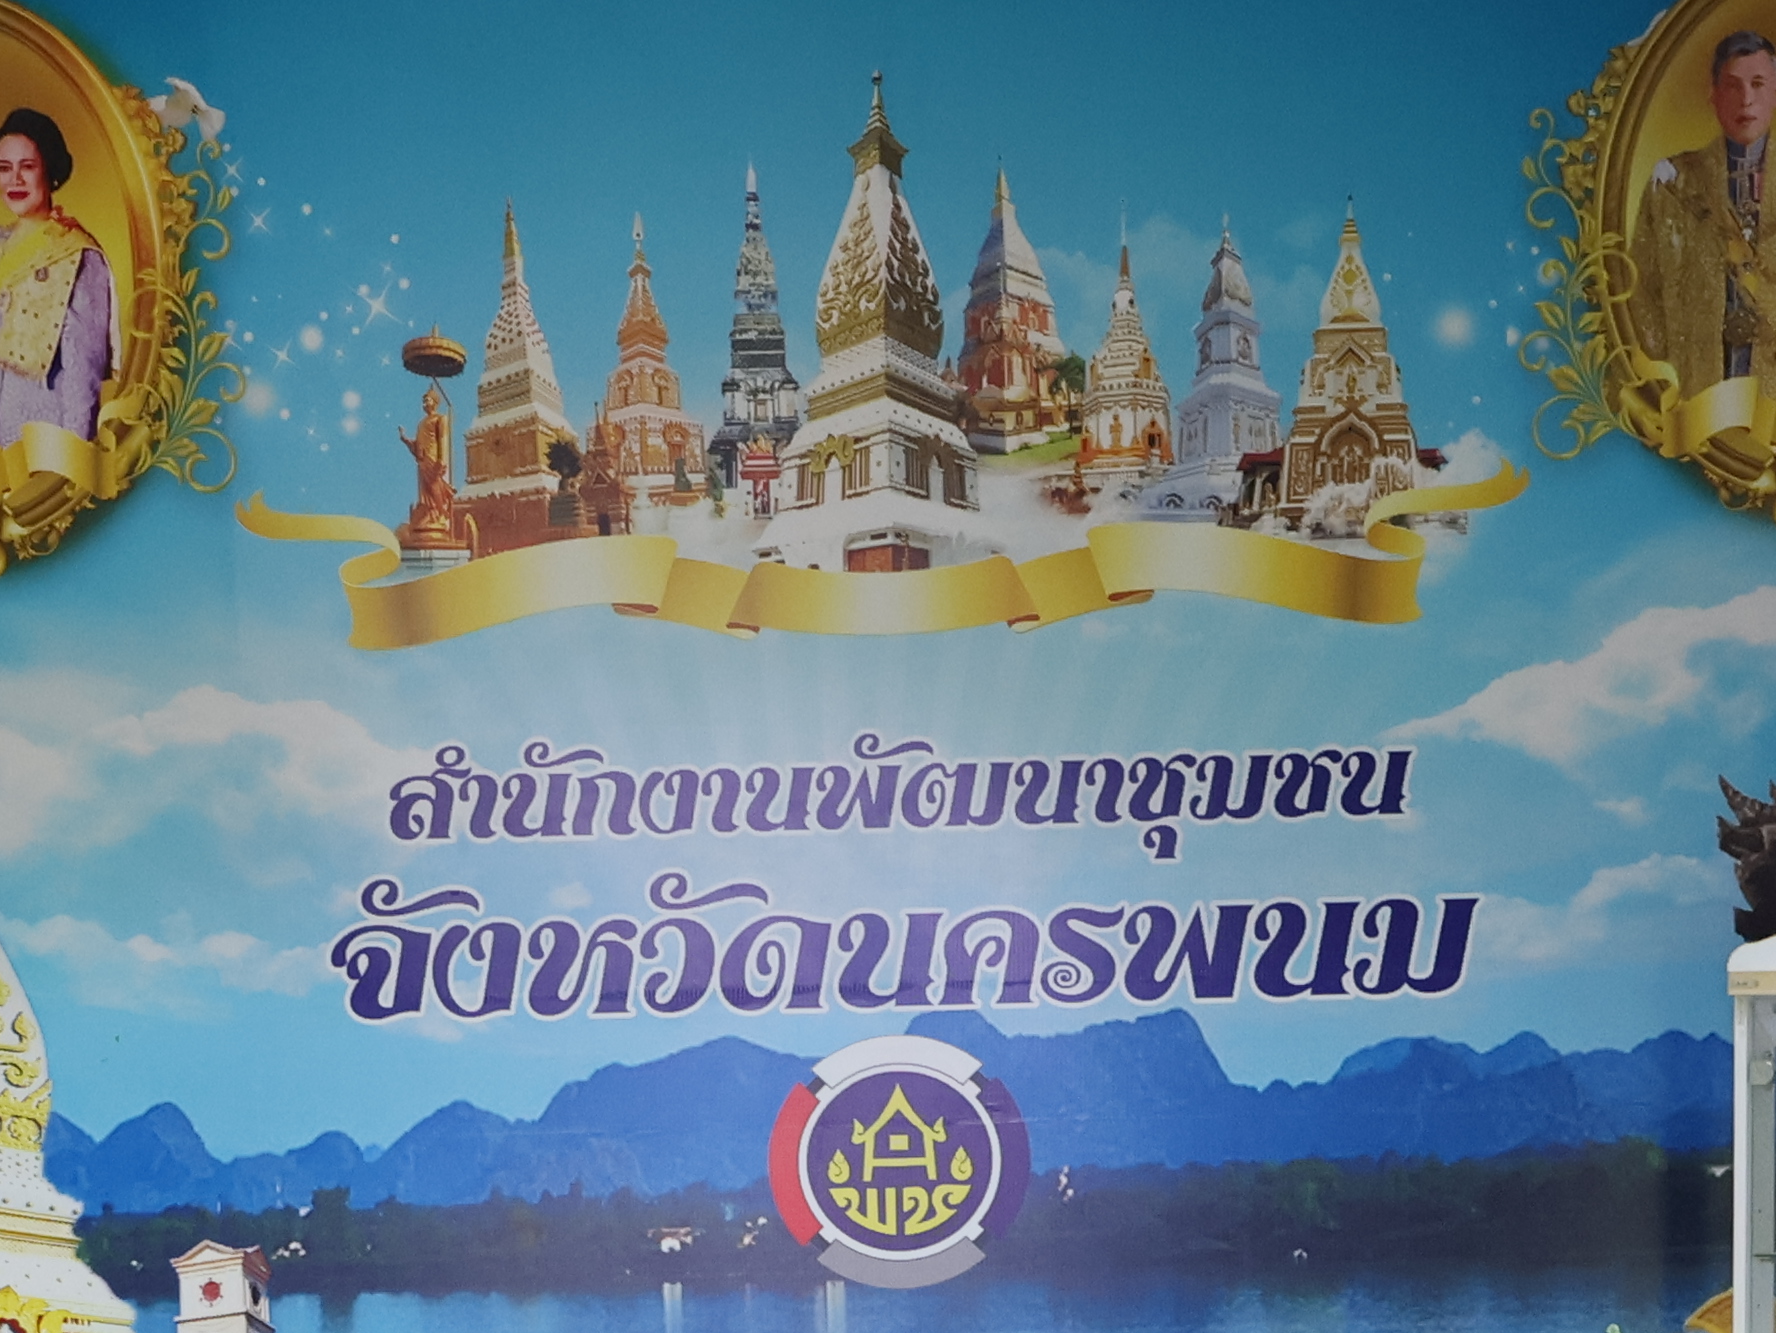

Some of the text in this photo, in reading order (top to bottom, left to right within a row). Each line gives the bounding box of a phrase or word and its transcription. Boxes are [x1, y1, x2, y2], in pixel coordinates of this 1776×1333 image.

[388, 733, 1414, 861] สำนักงานพัฒนาชุมชน
[330, 872, 1480, 1025] จังหวัดนครพนม
